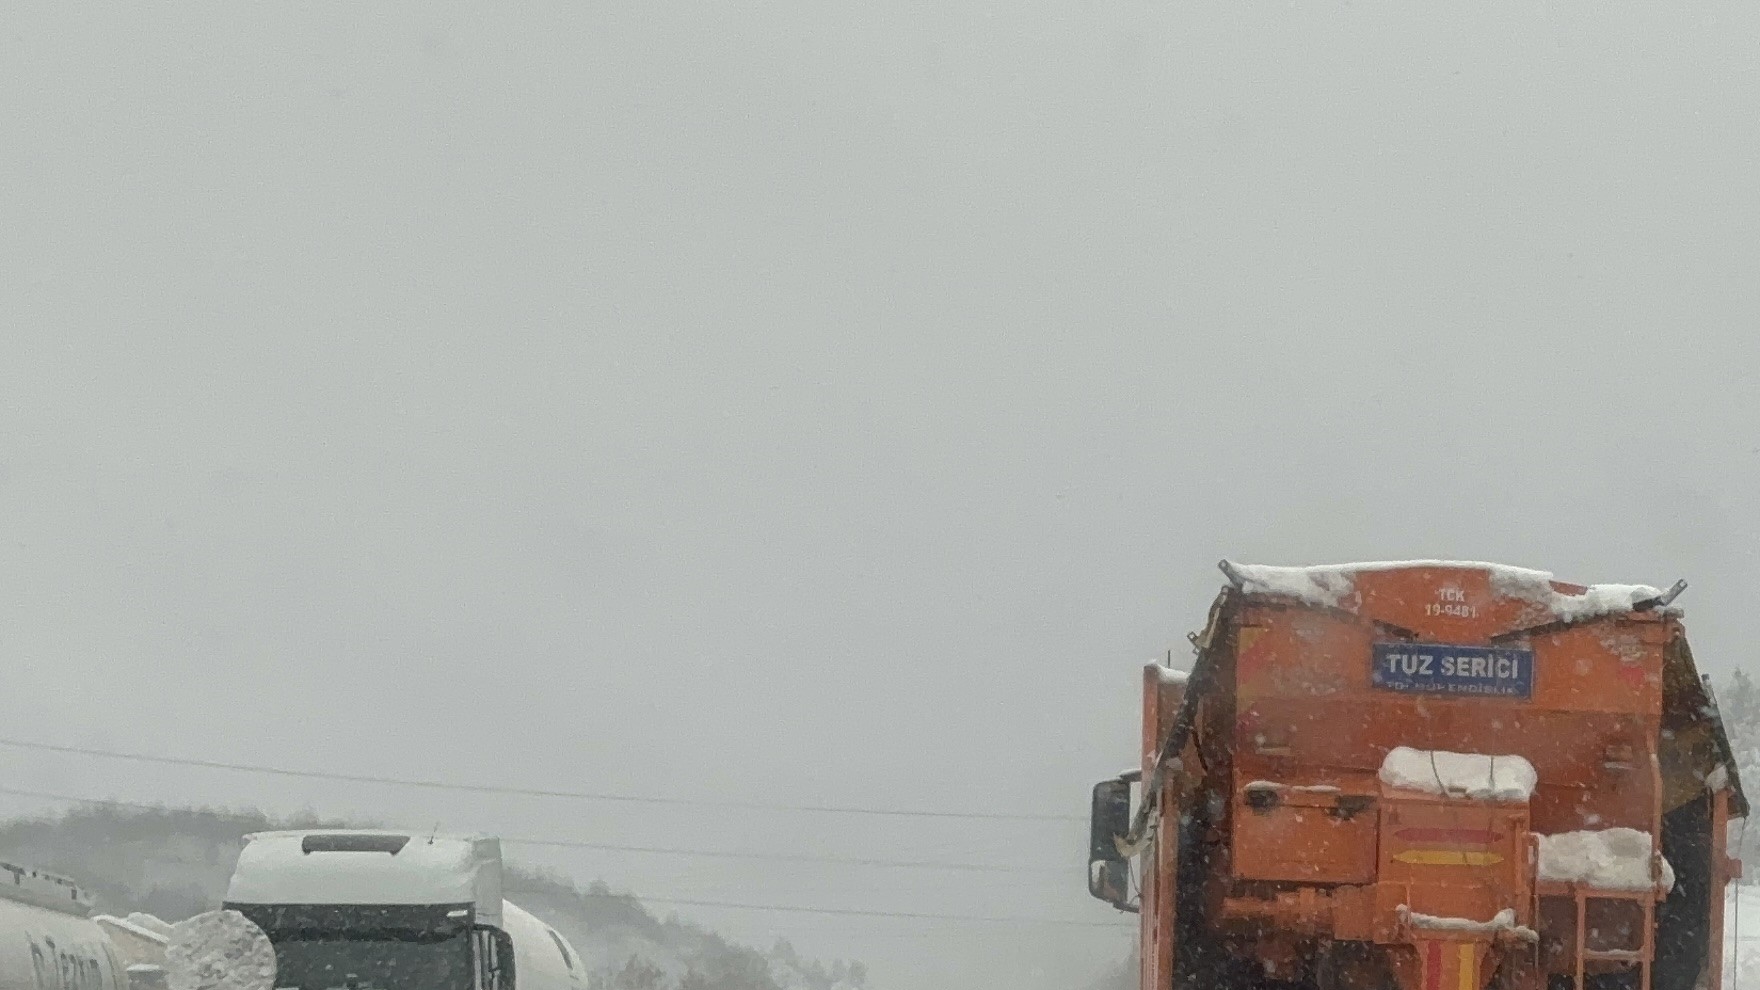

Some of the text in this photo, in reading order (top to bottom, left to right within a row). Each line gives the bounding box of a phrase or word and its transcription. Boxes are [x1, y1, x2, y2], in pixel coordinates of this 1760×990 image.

[1439, 588, 1465, 602] TCK
[1387, 653, 1519, 679] TUZ SERİCİ
